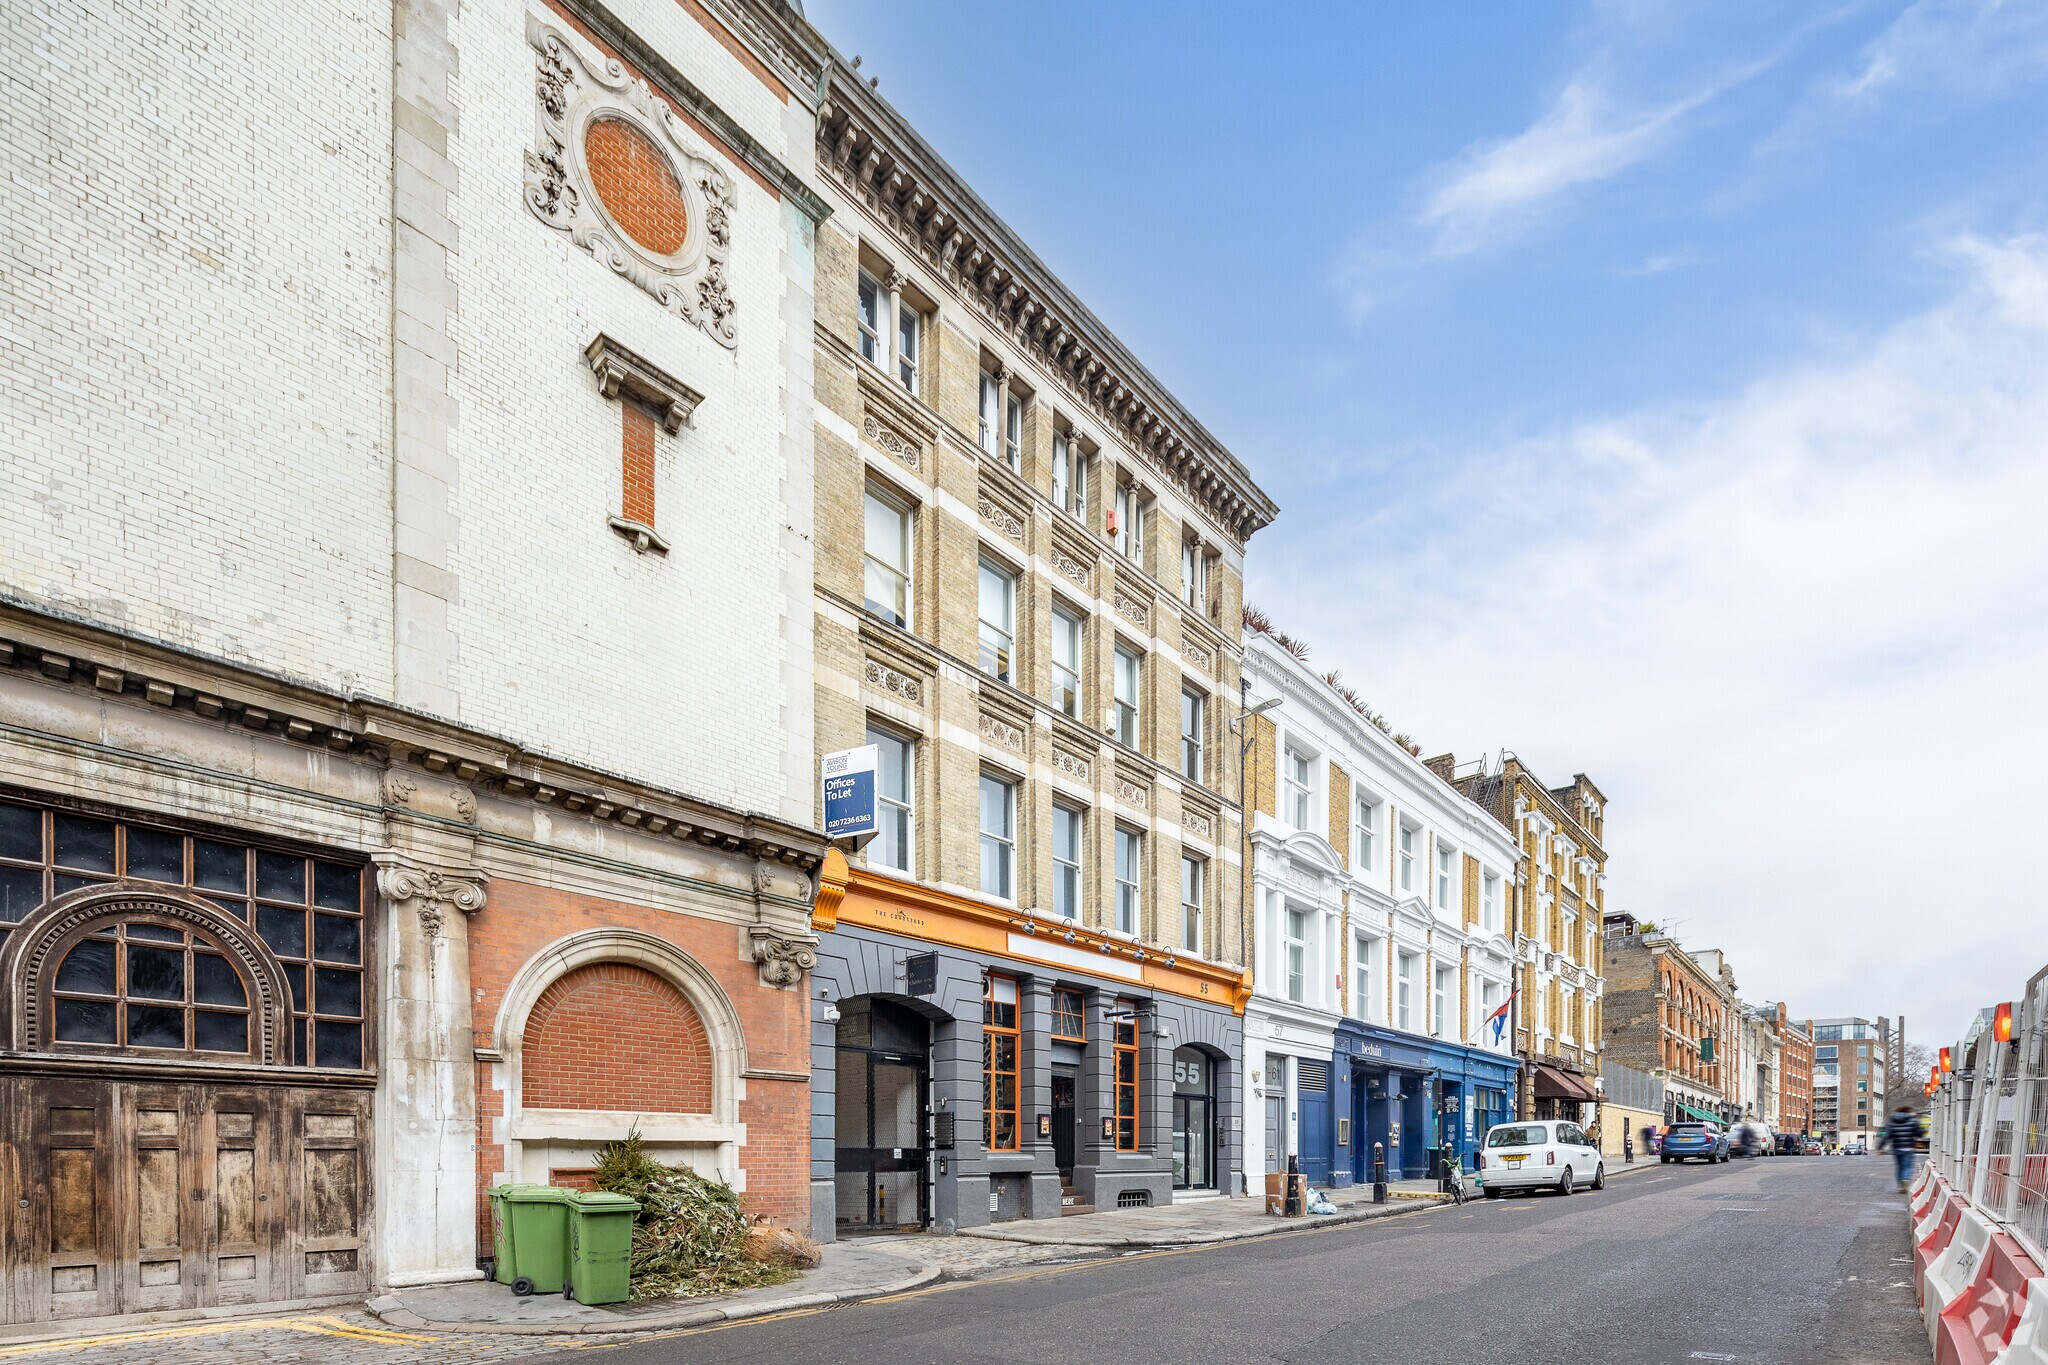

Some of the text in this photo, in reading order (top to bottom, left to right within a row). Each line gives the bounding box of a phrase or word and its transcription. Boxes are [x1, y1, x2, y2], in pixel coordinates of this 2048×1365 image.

[826, 757, 848, 767] AVISON
[826, 762, 848, 771] YOUNG
[826, 778, 855, 790] Offices
[826, 788, 852, 801] To Let
[829, 814, 871, 828] 020 7236 6363
[1200, 982, 1209, 994] 55
[1274, 1025, 1284, 1036] 57
[1174, 1061, 1200, 1084] 55
